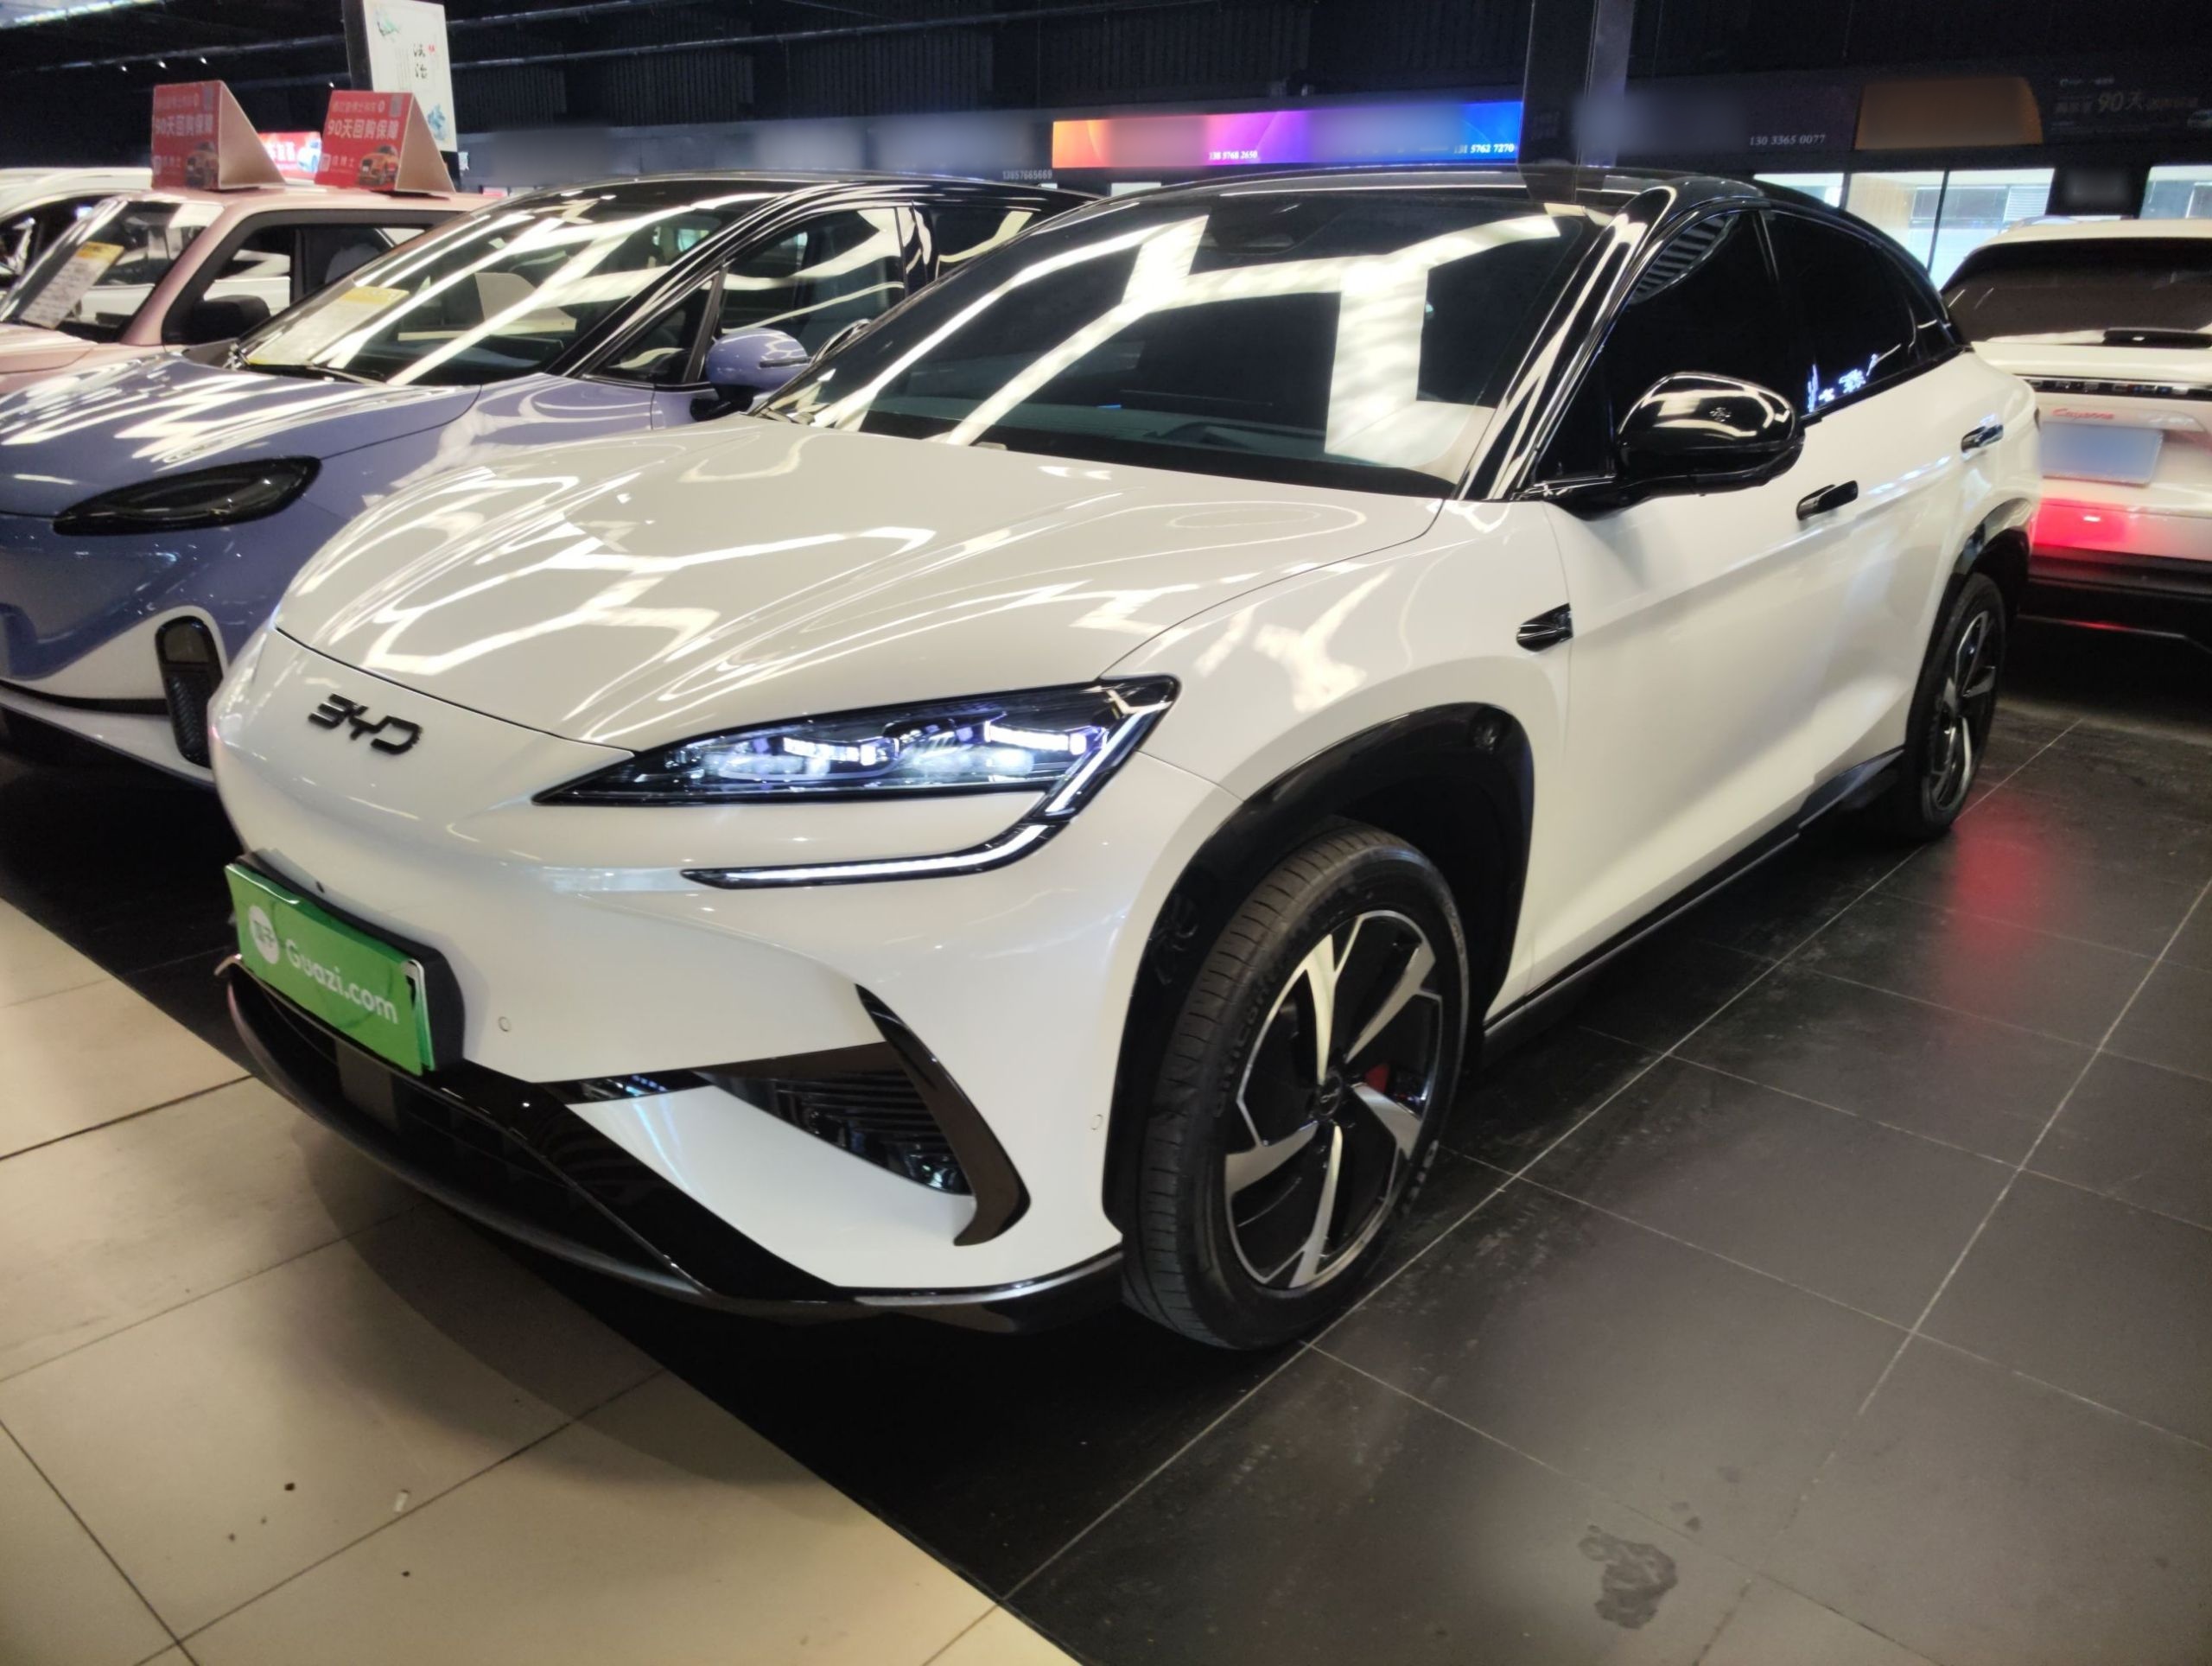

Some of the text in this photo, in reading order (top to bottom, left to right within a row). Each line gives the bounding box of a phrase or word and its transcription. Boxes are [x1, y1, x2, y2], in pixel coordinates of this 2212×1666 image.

[327, 118, 399, 140] 90天回购保障
[1750, 133, 1826, 146] 130 3365 0077
[1470, 143, 1491, 154] 5762
[308, 692, 423, 755] BYD
[284, 938, 399, 1025] Guazi.com
